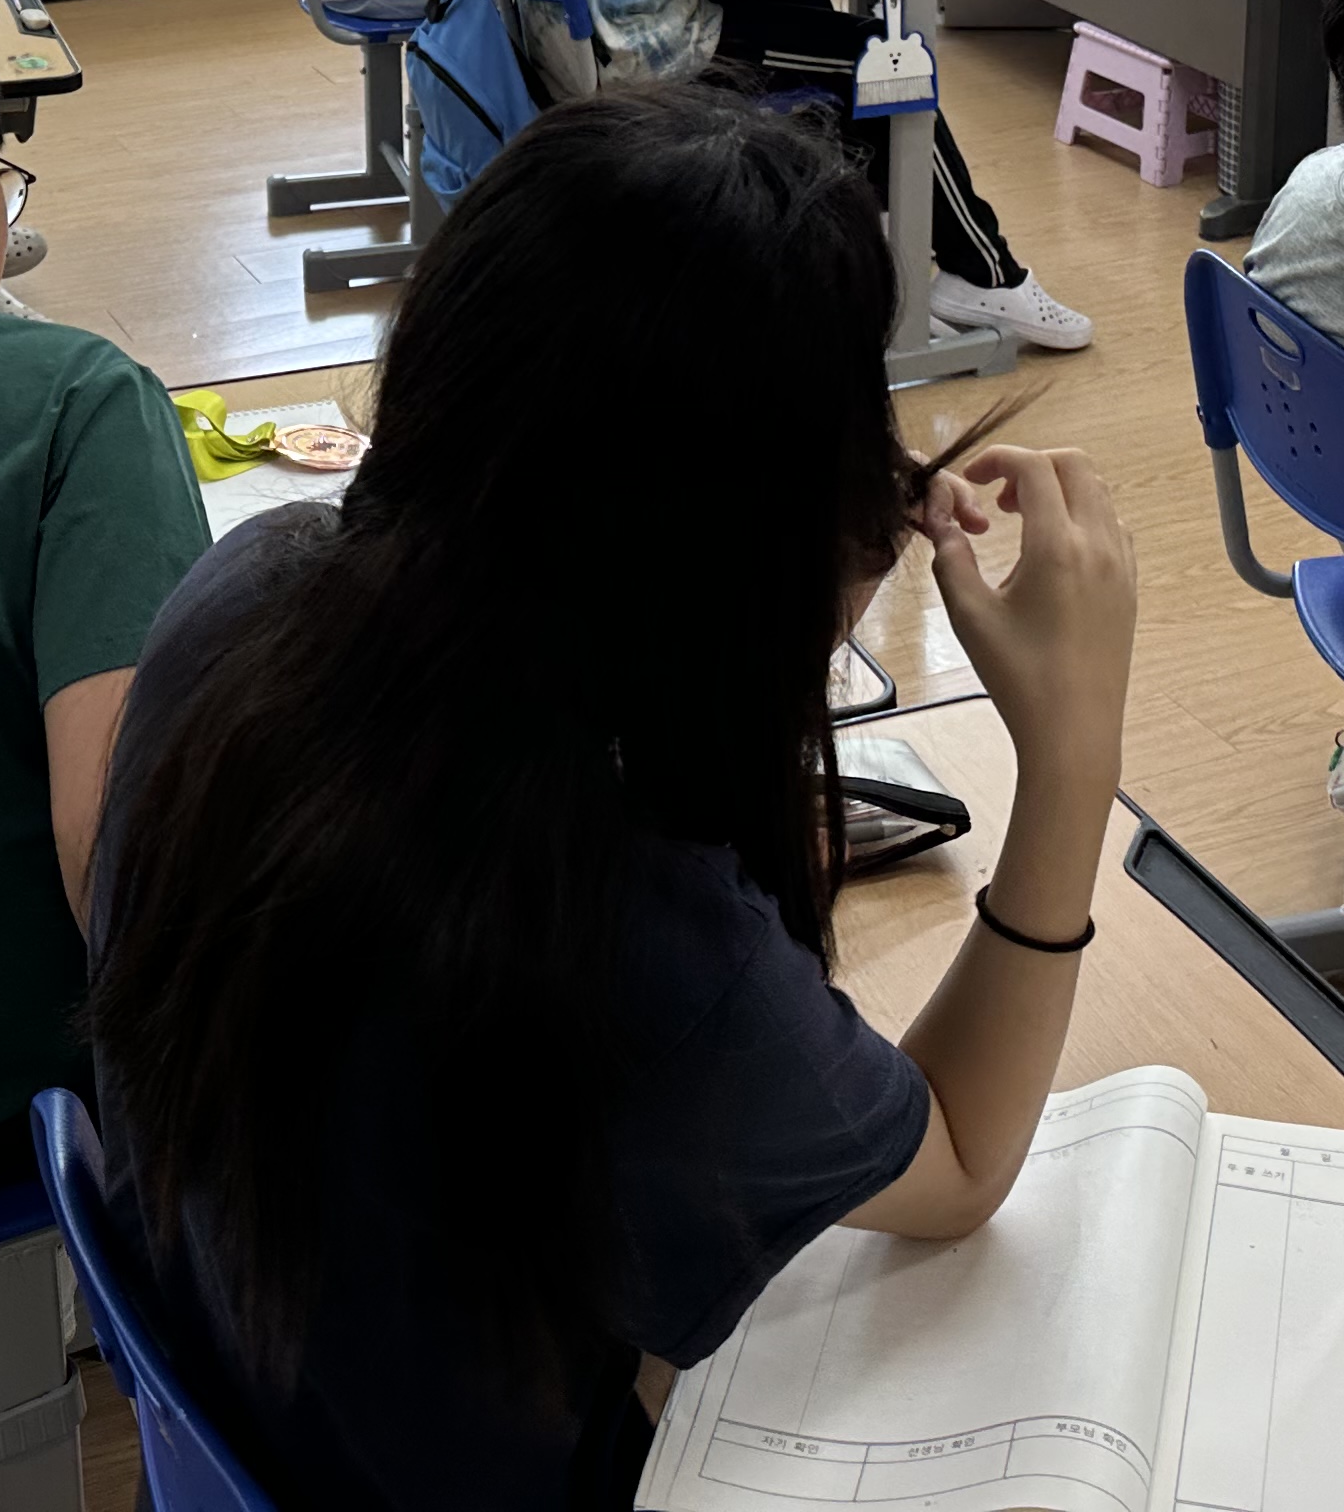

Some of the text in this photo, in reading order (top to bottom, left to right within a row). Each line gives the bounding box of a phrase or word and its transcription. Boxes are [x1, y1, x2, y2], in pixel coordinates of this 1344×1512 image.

[761, 1435, 820, 1456] 자기 확인
[907, 1435, 976, 1458] 선생님 확인
[1056, 1422, 1129, 1454] 부모님 확인
